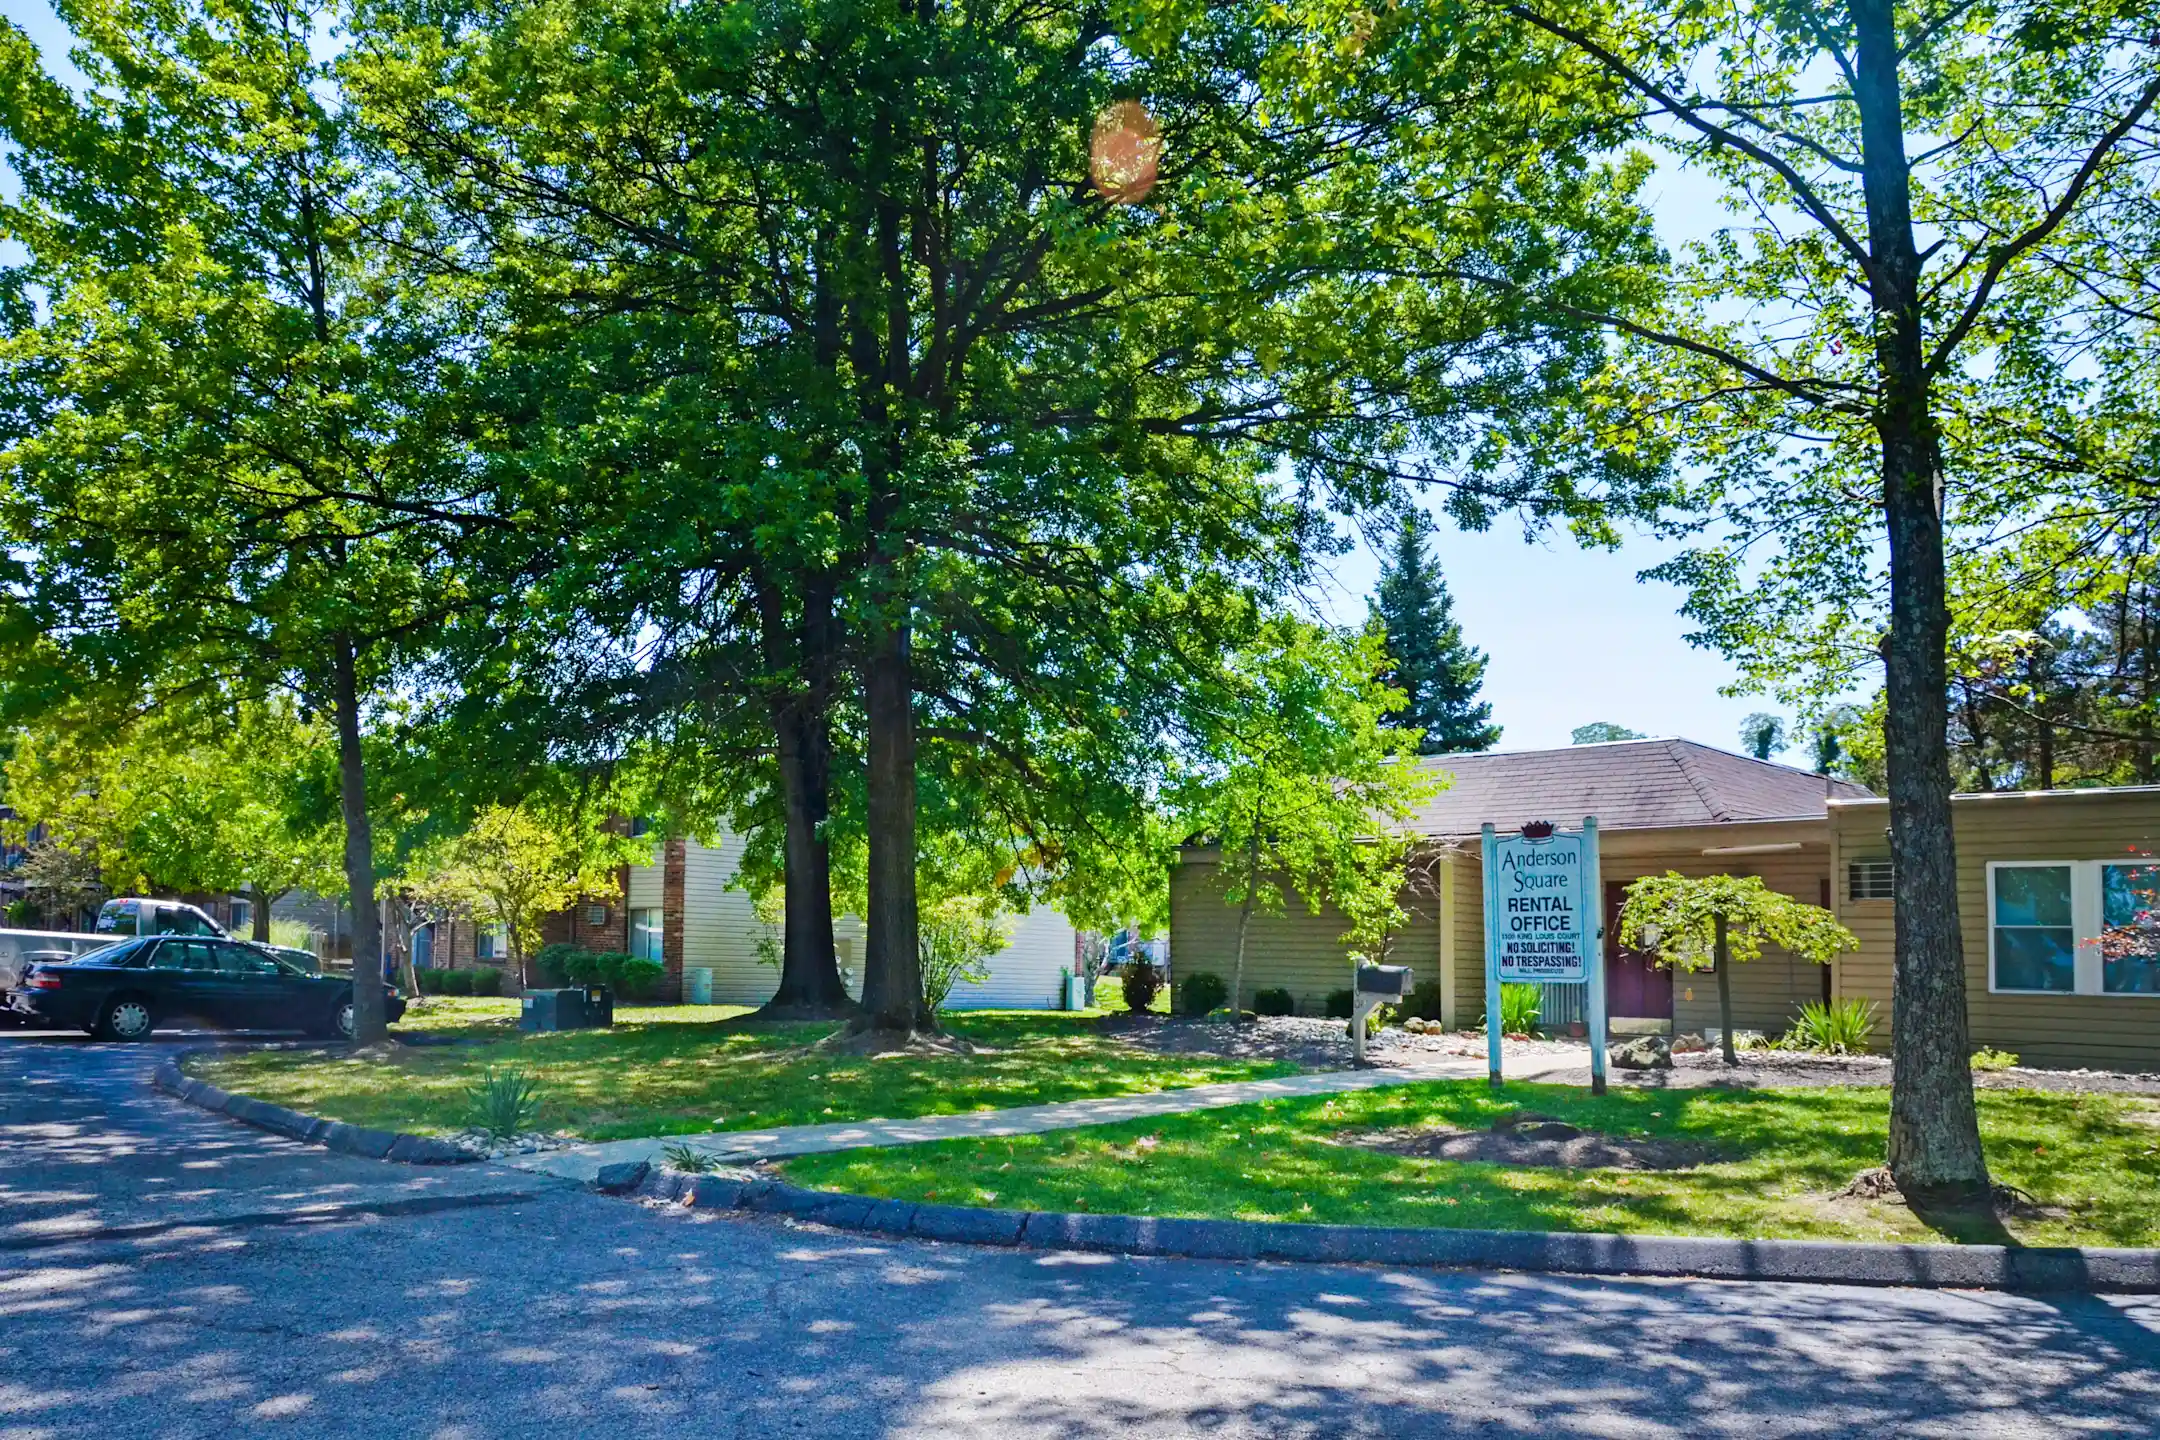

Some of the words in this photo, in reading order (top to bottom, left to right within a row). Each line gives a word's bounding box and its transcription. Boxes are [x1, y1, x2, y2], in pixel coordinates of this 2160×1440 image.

[1502, 848, 1576, 871] Anderson
[1514, 871, 1568, 892] Square
[1508, 897, 1573, 912] RENTAL
[1511, 916, 1570, 931] OFFICE
[1507, 942, 1519, 953] NO
[1521, 942, 1575, 953] SOLICITING!
[1502, 956, 1513, 967] NO
[1516, 956, 1581, 967] TRESPASSING!
